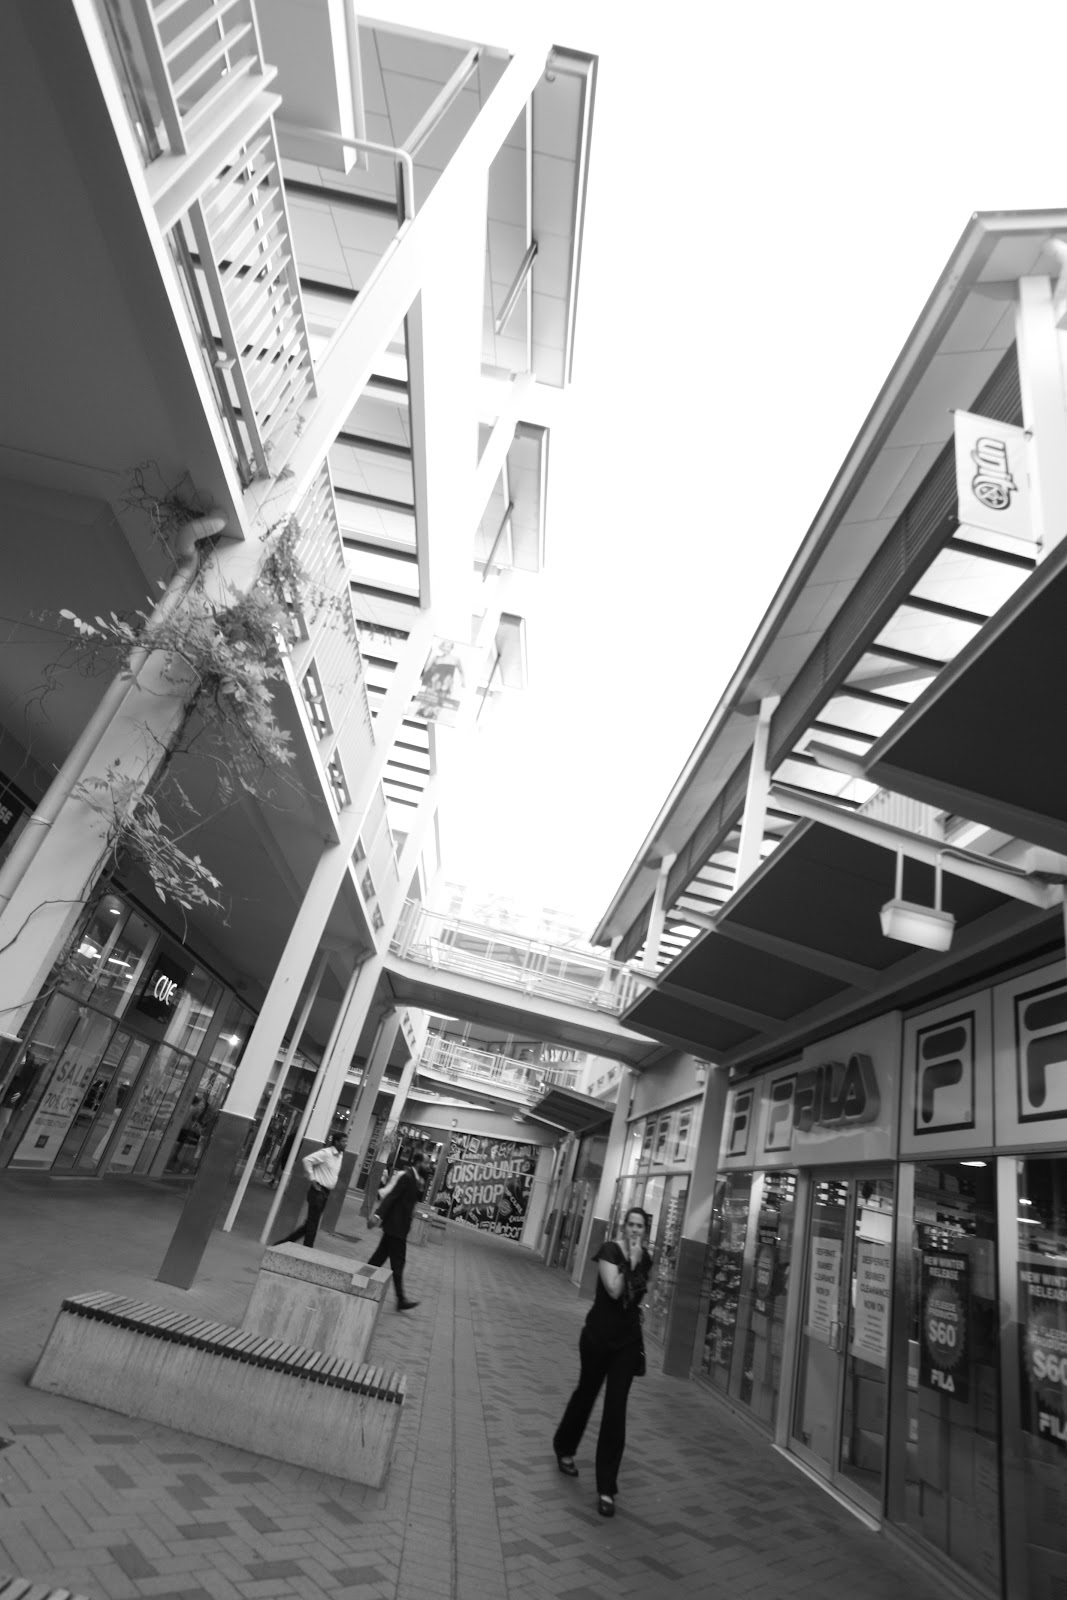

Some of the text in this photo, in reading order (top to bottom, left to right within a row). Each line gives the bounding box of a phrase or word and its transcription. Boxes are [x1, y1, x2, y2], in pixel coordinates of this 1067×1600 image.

[0, 803, 13, 825] SE
[154, 974, 177, 1005] CUE
[540, 1049, 580, 1063] AWOL
[56, 1061, 92, 1088] SALE
[922, 1026, 966, 1123] F
[794, 1053, 878, 1131] FILA
[61, 1097, 79, 1112] OFF
[452, 1159, 524, 1183] DISCOUNT
[463, 1184, 504, 1205] SHOP
[862, 1255, 890, 1269] DESPERATE
[924, 1255, 965, 1271] NEW WINTER
[929, 1267, 959, 1281] RELEASE
[1020, 1271, 1041, 1284] NEW
[860, 1283, 890, 1299] CLEARANCE
[864, 1300, 885, 1314] NOW ON
[935, 1301, 957, 1313] FLEECE
[929, 1320, 956, 1347] $60
[931, 1369, 955, 1392] FILA
